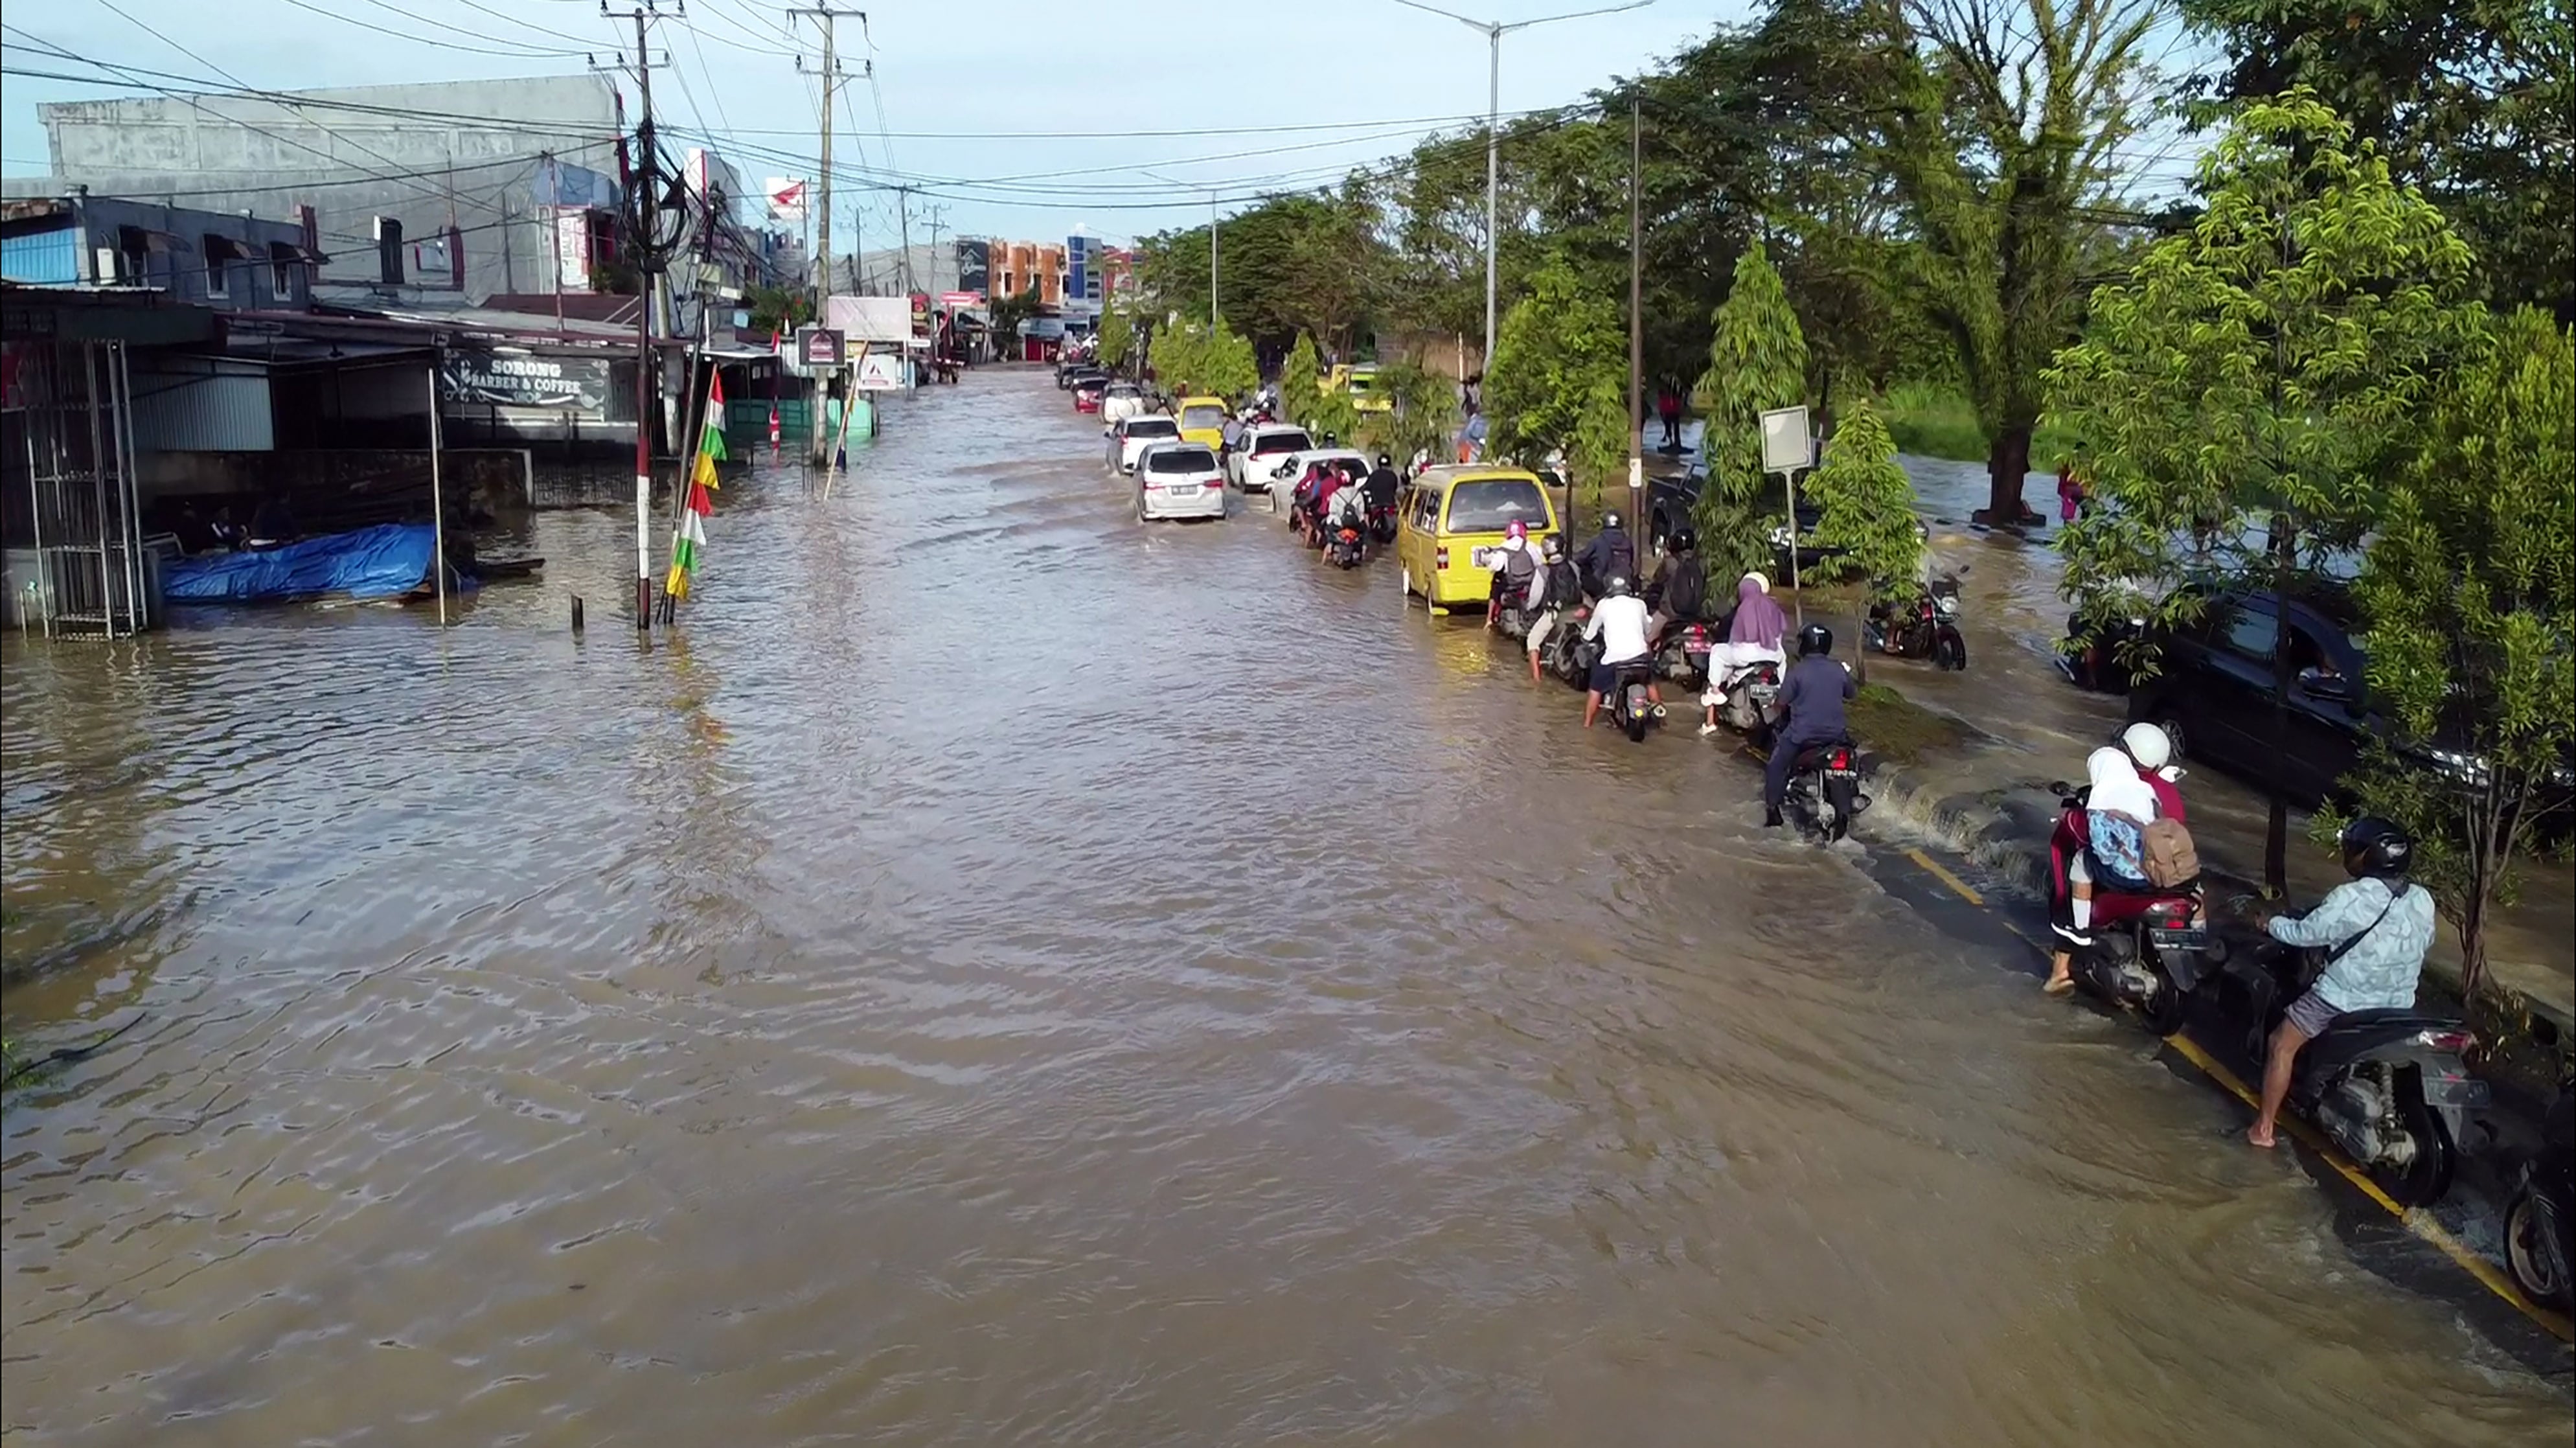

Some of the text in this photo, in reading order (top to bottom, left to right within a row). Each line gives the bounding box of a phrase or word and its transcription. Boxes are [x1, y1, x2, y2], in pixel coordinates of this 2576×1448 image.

[492, 360, 562, 377] SORONG
[471, 375, 519, 389] BARBER
[534, 378, 581, 394] COFFEE
[514, 391, 541, 404] SHOP
